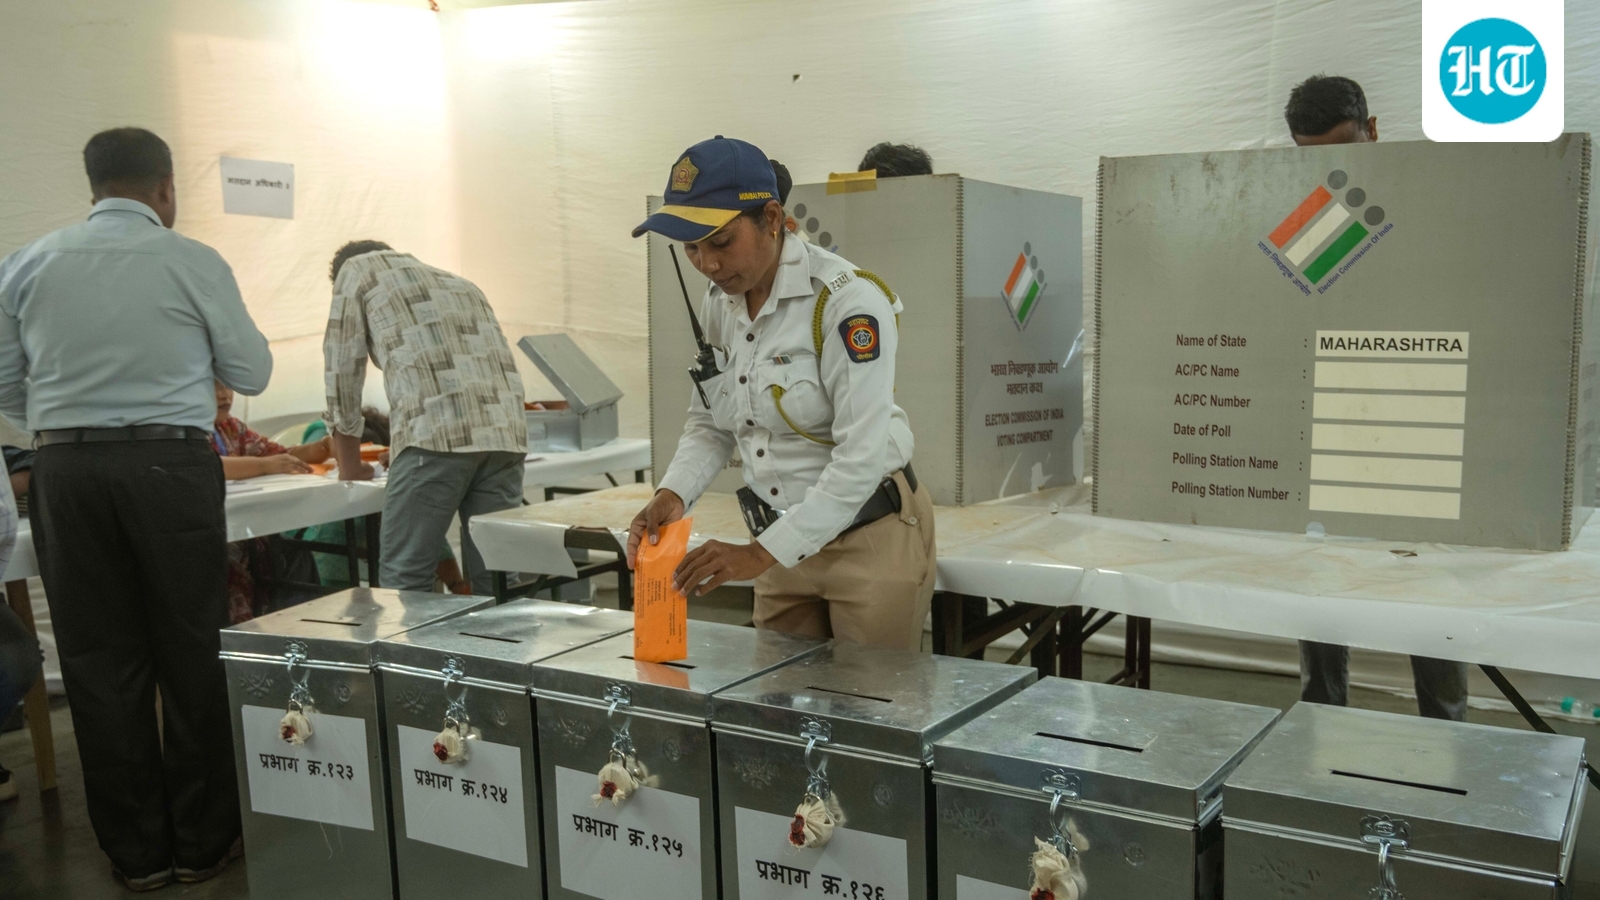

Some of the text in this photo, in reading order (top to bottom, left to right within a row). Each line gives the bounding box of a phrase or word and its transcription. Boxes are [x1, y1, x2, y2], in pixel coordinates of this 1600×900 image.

[739, 192, 758, 200] MUMBAI
[1317, 222, 1394, 294] Election Commission Of India
[1176, 334, 1204, 347] Name
[1207, 335, 1218, 347] of
[1220, 334, 1247, 347] State
[1320, 337, 1463, 352] MAHARASHTRA
[1175, 363, 1208, 376] AC/PC
[1210, 365, 1240, 377] Name
[1174, 393, 1207, 406] AC/PC
[1210, 394, 1251, 408] Number
[985, 408, 1064, 427] ELECTION COMMISSION OF INDIA
[997, 429, 1053, 447] VOTING COMPARTMENT
[1173, 422, 1196, 436] Date
[1198, 424, 1210, 436] of
[1211, 424, 1231, 437] Poll
[729, 458, 743, 468] Stat
[1172, 452, 1207, 469] Polling
[1210, 454, 1246, 468] Station
[1248, 456, 1279, 469] Name
[1171, 481, 1206, 498] Polling
[1208, 483, 1245, 498] Station
[1247, 486, 1289, 500] Number
[259, 753, 354, 781] प्रभाग क्र.१२३
[414, 768, 508, 804] प्रभाग क्र.१२४
[572, 813, 684, 858] प्रभाग क्र.१२५
[755, 859, 810, 889] प्रभाग
